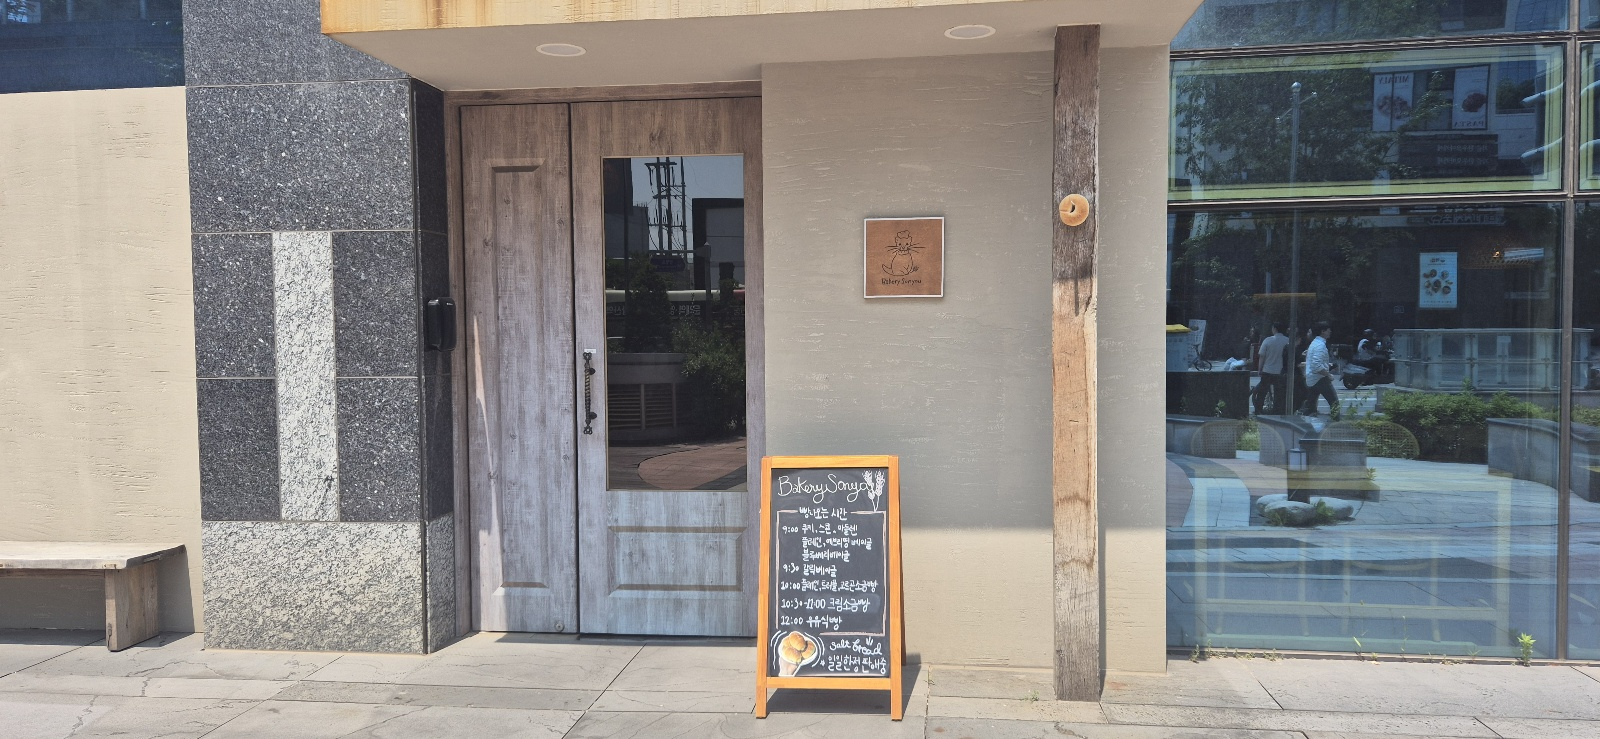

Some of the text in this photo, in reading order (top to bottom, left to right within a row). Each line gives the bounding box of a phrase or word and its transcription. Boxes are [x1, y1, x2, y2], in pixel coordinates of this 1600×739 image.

[882, 278, 900, 286] Bakery
[778, 475, 826, 503] Bakery
[831, 507, 847, 521] 시간
[782, 525, 799, 535] 9:00
[837, 524, 857, 537] 마들렌
[782, 562, 800, 574] 9:30
[781, 580, 801, 591] 10:00
[828, 596, 870, 613] 크림소금빵
[781, 614, 842, 631] 12:00 우유식빵
